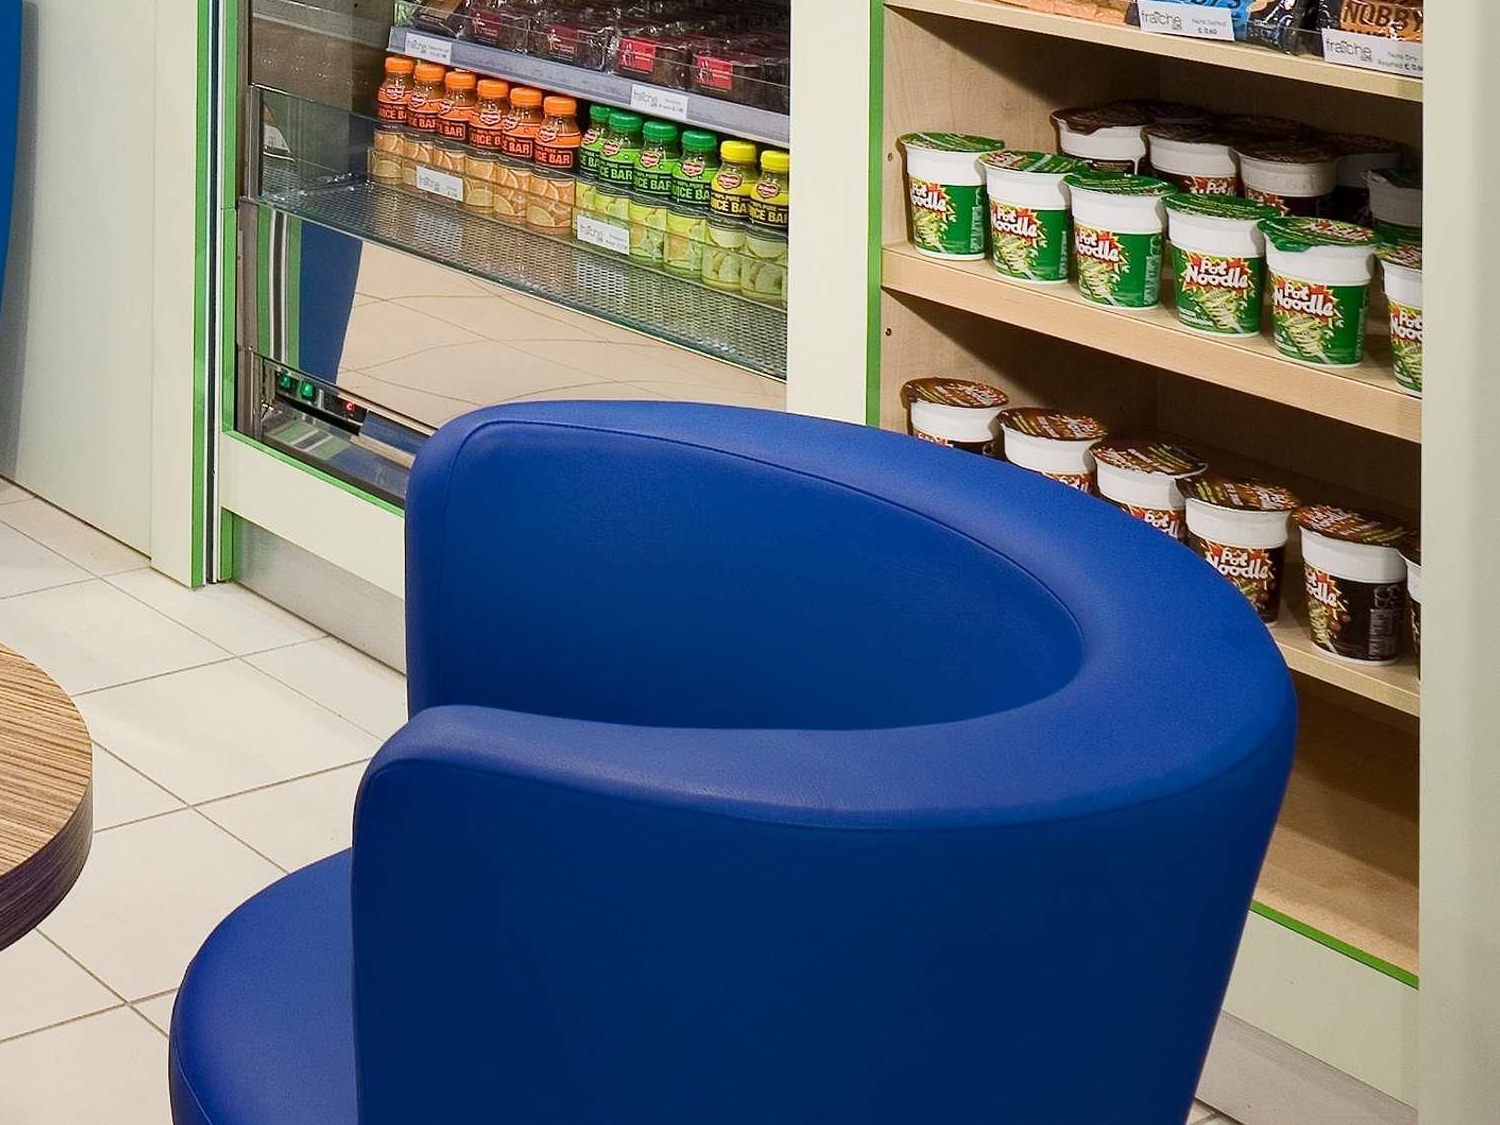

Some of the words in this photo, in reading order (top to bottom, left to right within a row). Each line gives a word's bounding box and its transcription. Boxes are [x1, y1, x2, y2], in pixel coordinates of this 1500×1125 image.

[444, 127, 463, 137] BAR
[509, 140, 530, 155] BAR
[549, 152, 570, 165] BAR
[610, 168, 632, 180] BAR
[912, 183, 927, 197] Pot
[911, 191, 947, 212] oodle
[997, 205, 1018, 222] Pot
[1078, 226, 1098, 245] Pot
[1200, 259, 1228, 275] Pot
[1185, 266, 1249, 288] Noodle
[1284, 281, 1310, 299] Pot
[1273, 288, 1334, 316] Noodle
[1221, 548, 1248, 567] Pot
